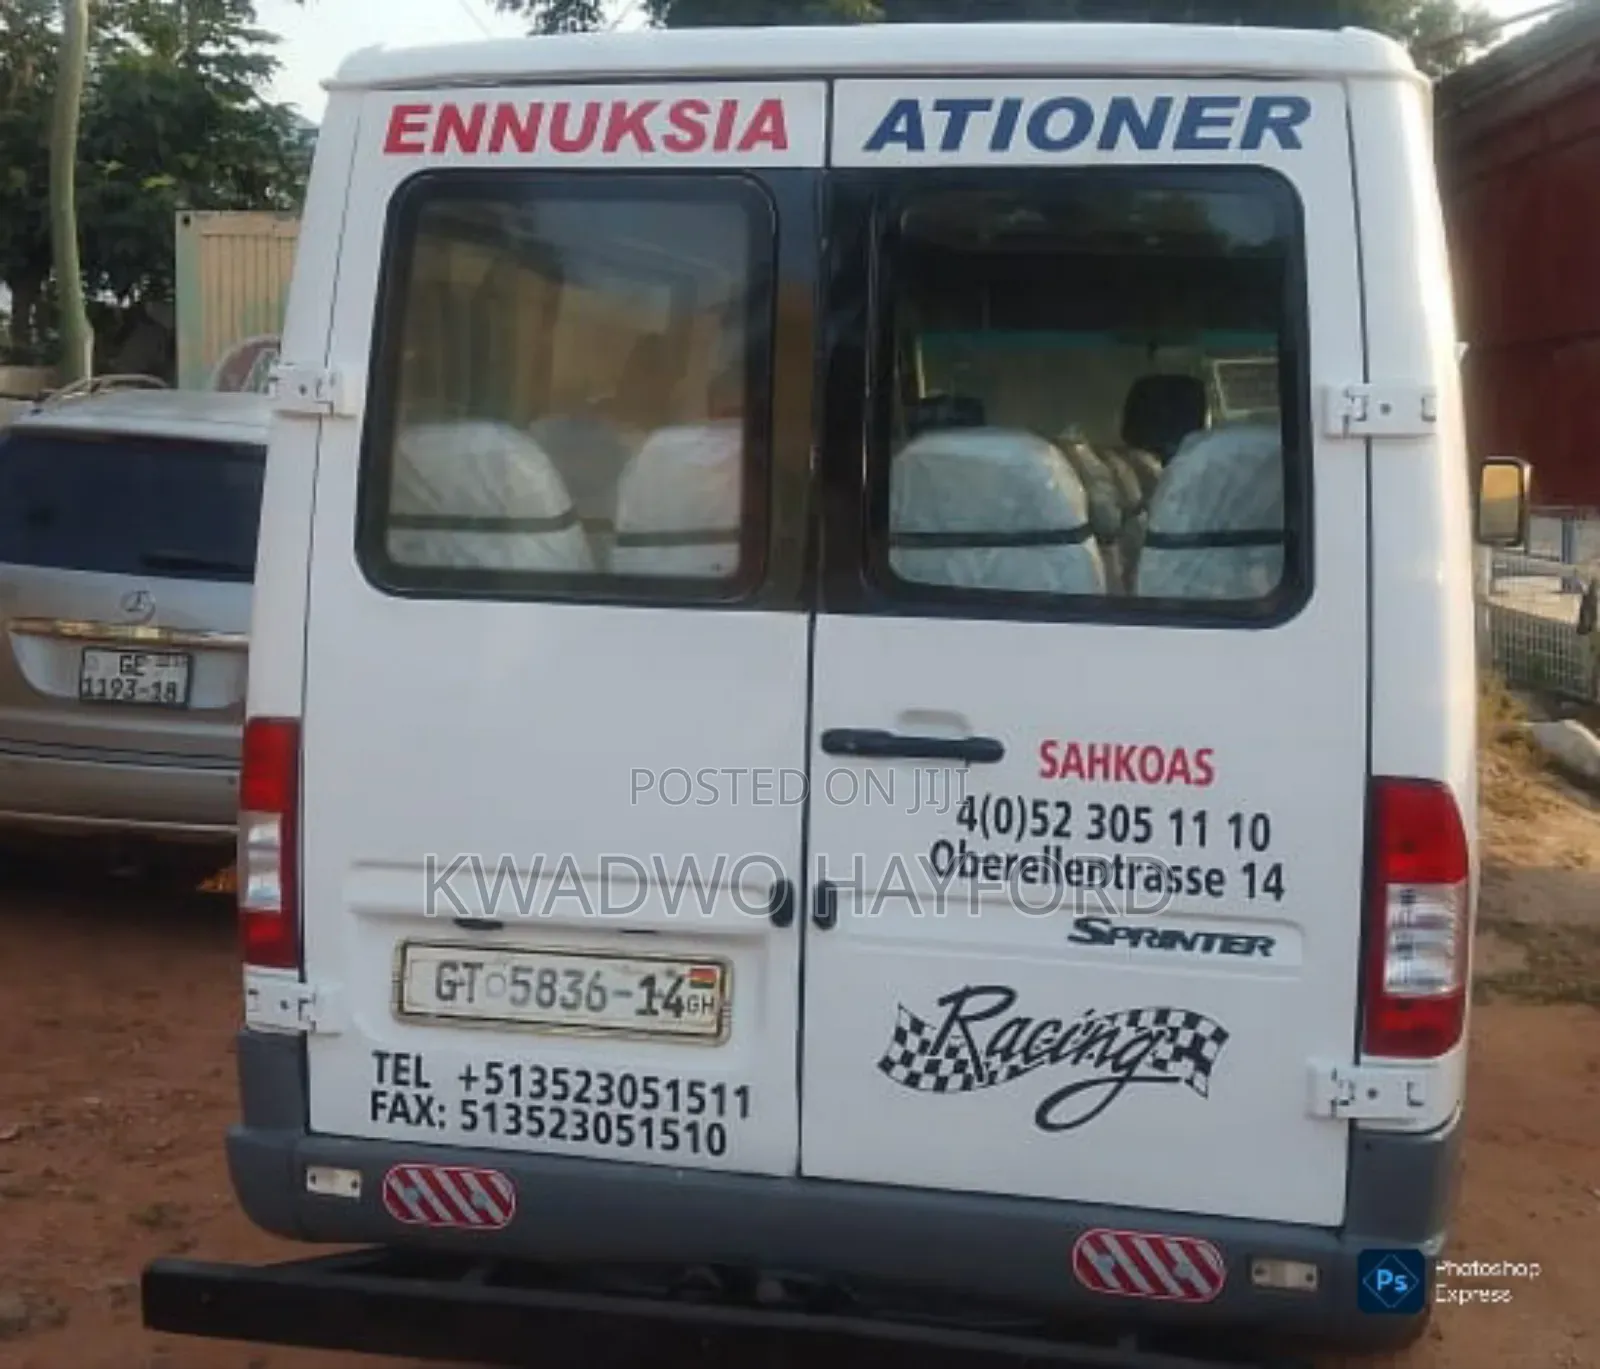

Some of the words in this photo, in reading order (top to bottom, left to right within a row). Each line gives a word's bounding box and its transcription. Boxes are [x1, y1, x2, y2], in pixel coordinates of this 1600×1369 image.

[383, 97, 790, 155] ENNUKSIA
[861, 95, 1312, 152] ATIONER
[1039, 740, 1215, 787] SAHKOAS
[956, 793, 1073, 842] 4(0)52
[1086, 803, 1153, 844] 305
[1168, 808, 1208, 848] 11
[1228, 812, 1271, 852] 10
[1243, 862, 1286, 902] 14
[435, 960, 484, 1003] GT
[686, 993, 715, 1016] GH
[371, 1050, 431, 1090] TEL
[457, 1061, 752, 1119] +513523051511
[930, 985, 1182, 1132] Racing
[370, 1090, 447, 1129] FAX:
[460, 1099, 727, 1157] 513523051510
